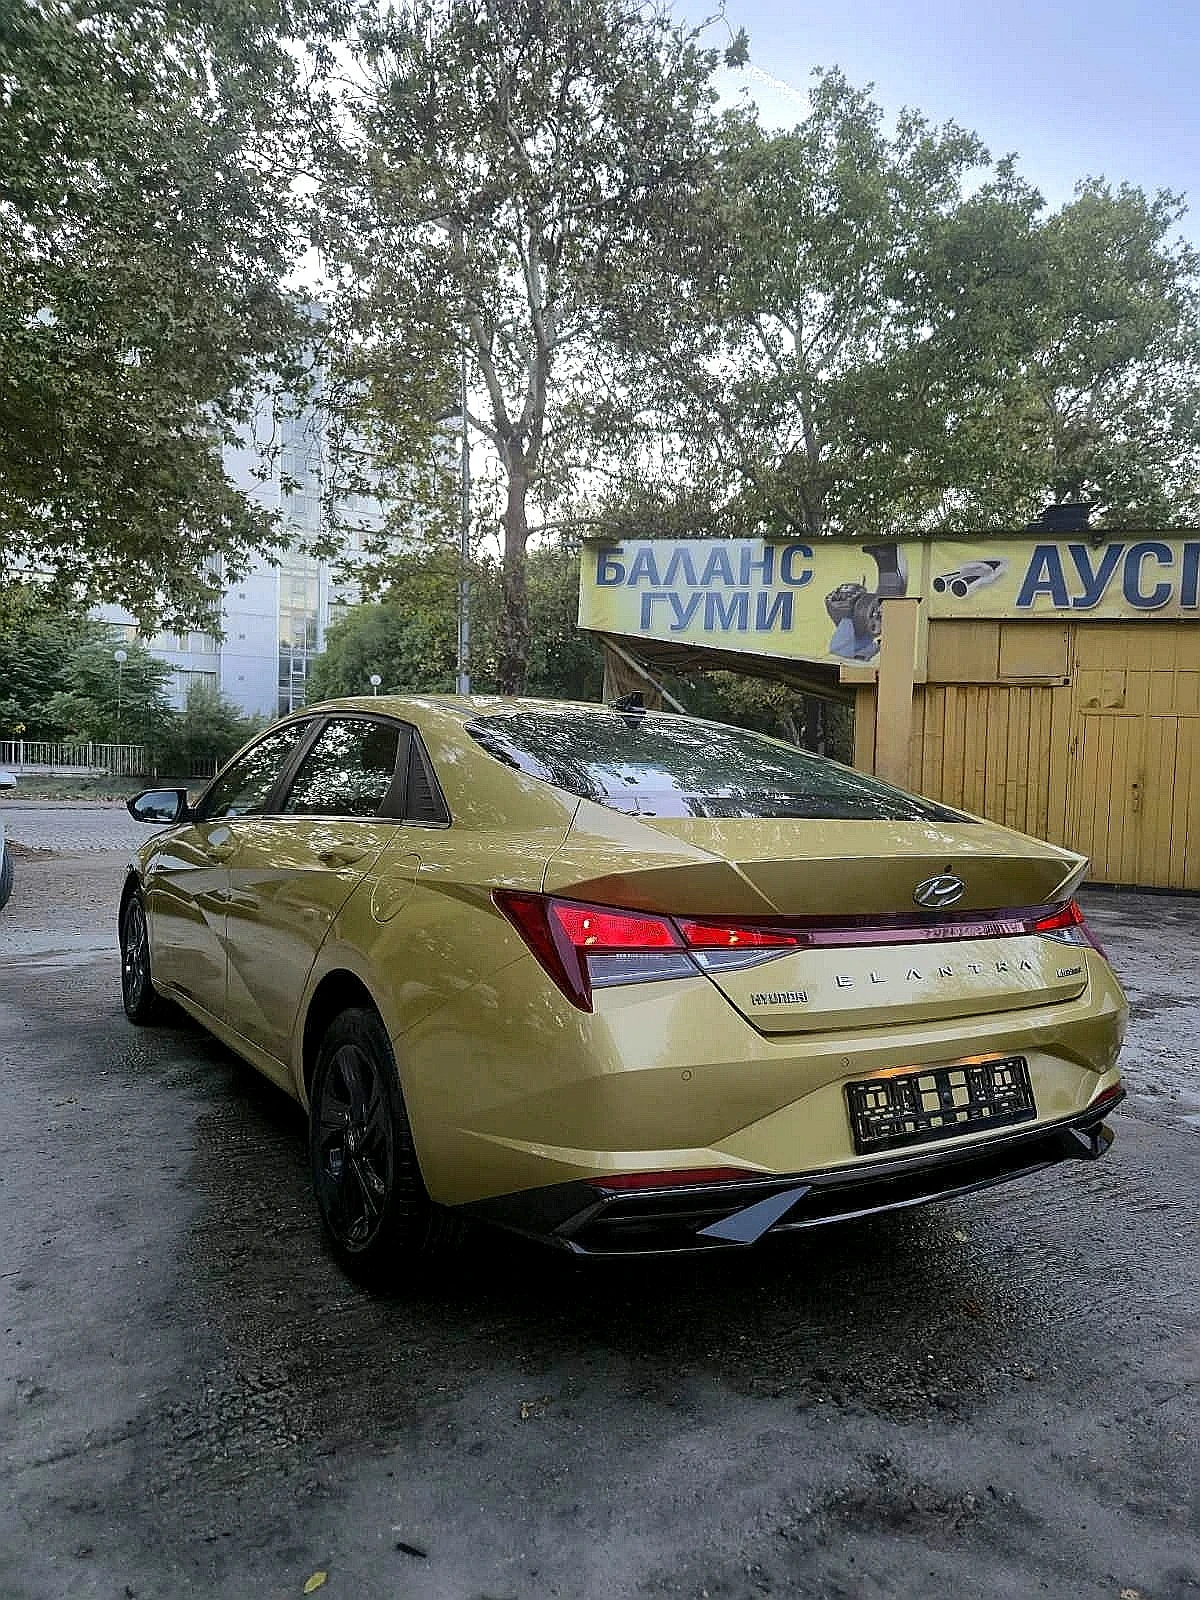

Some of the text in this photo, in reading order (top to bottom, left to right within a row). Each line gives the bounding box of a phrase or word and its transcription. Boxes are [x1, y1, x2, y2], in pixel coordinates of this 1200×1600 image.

[596, 544, 814, 587] БАЛАНС
[639, 591, 794, 632] ГУМИ
[835, 959, 1032, 988] ELANTRA
